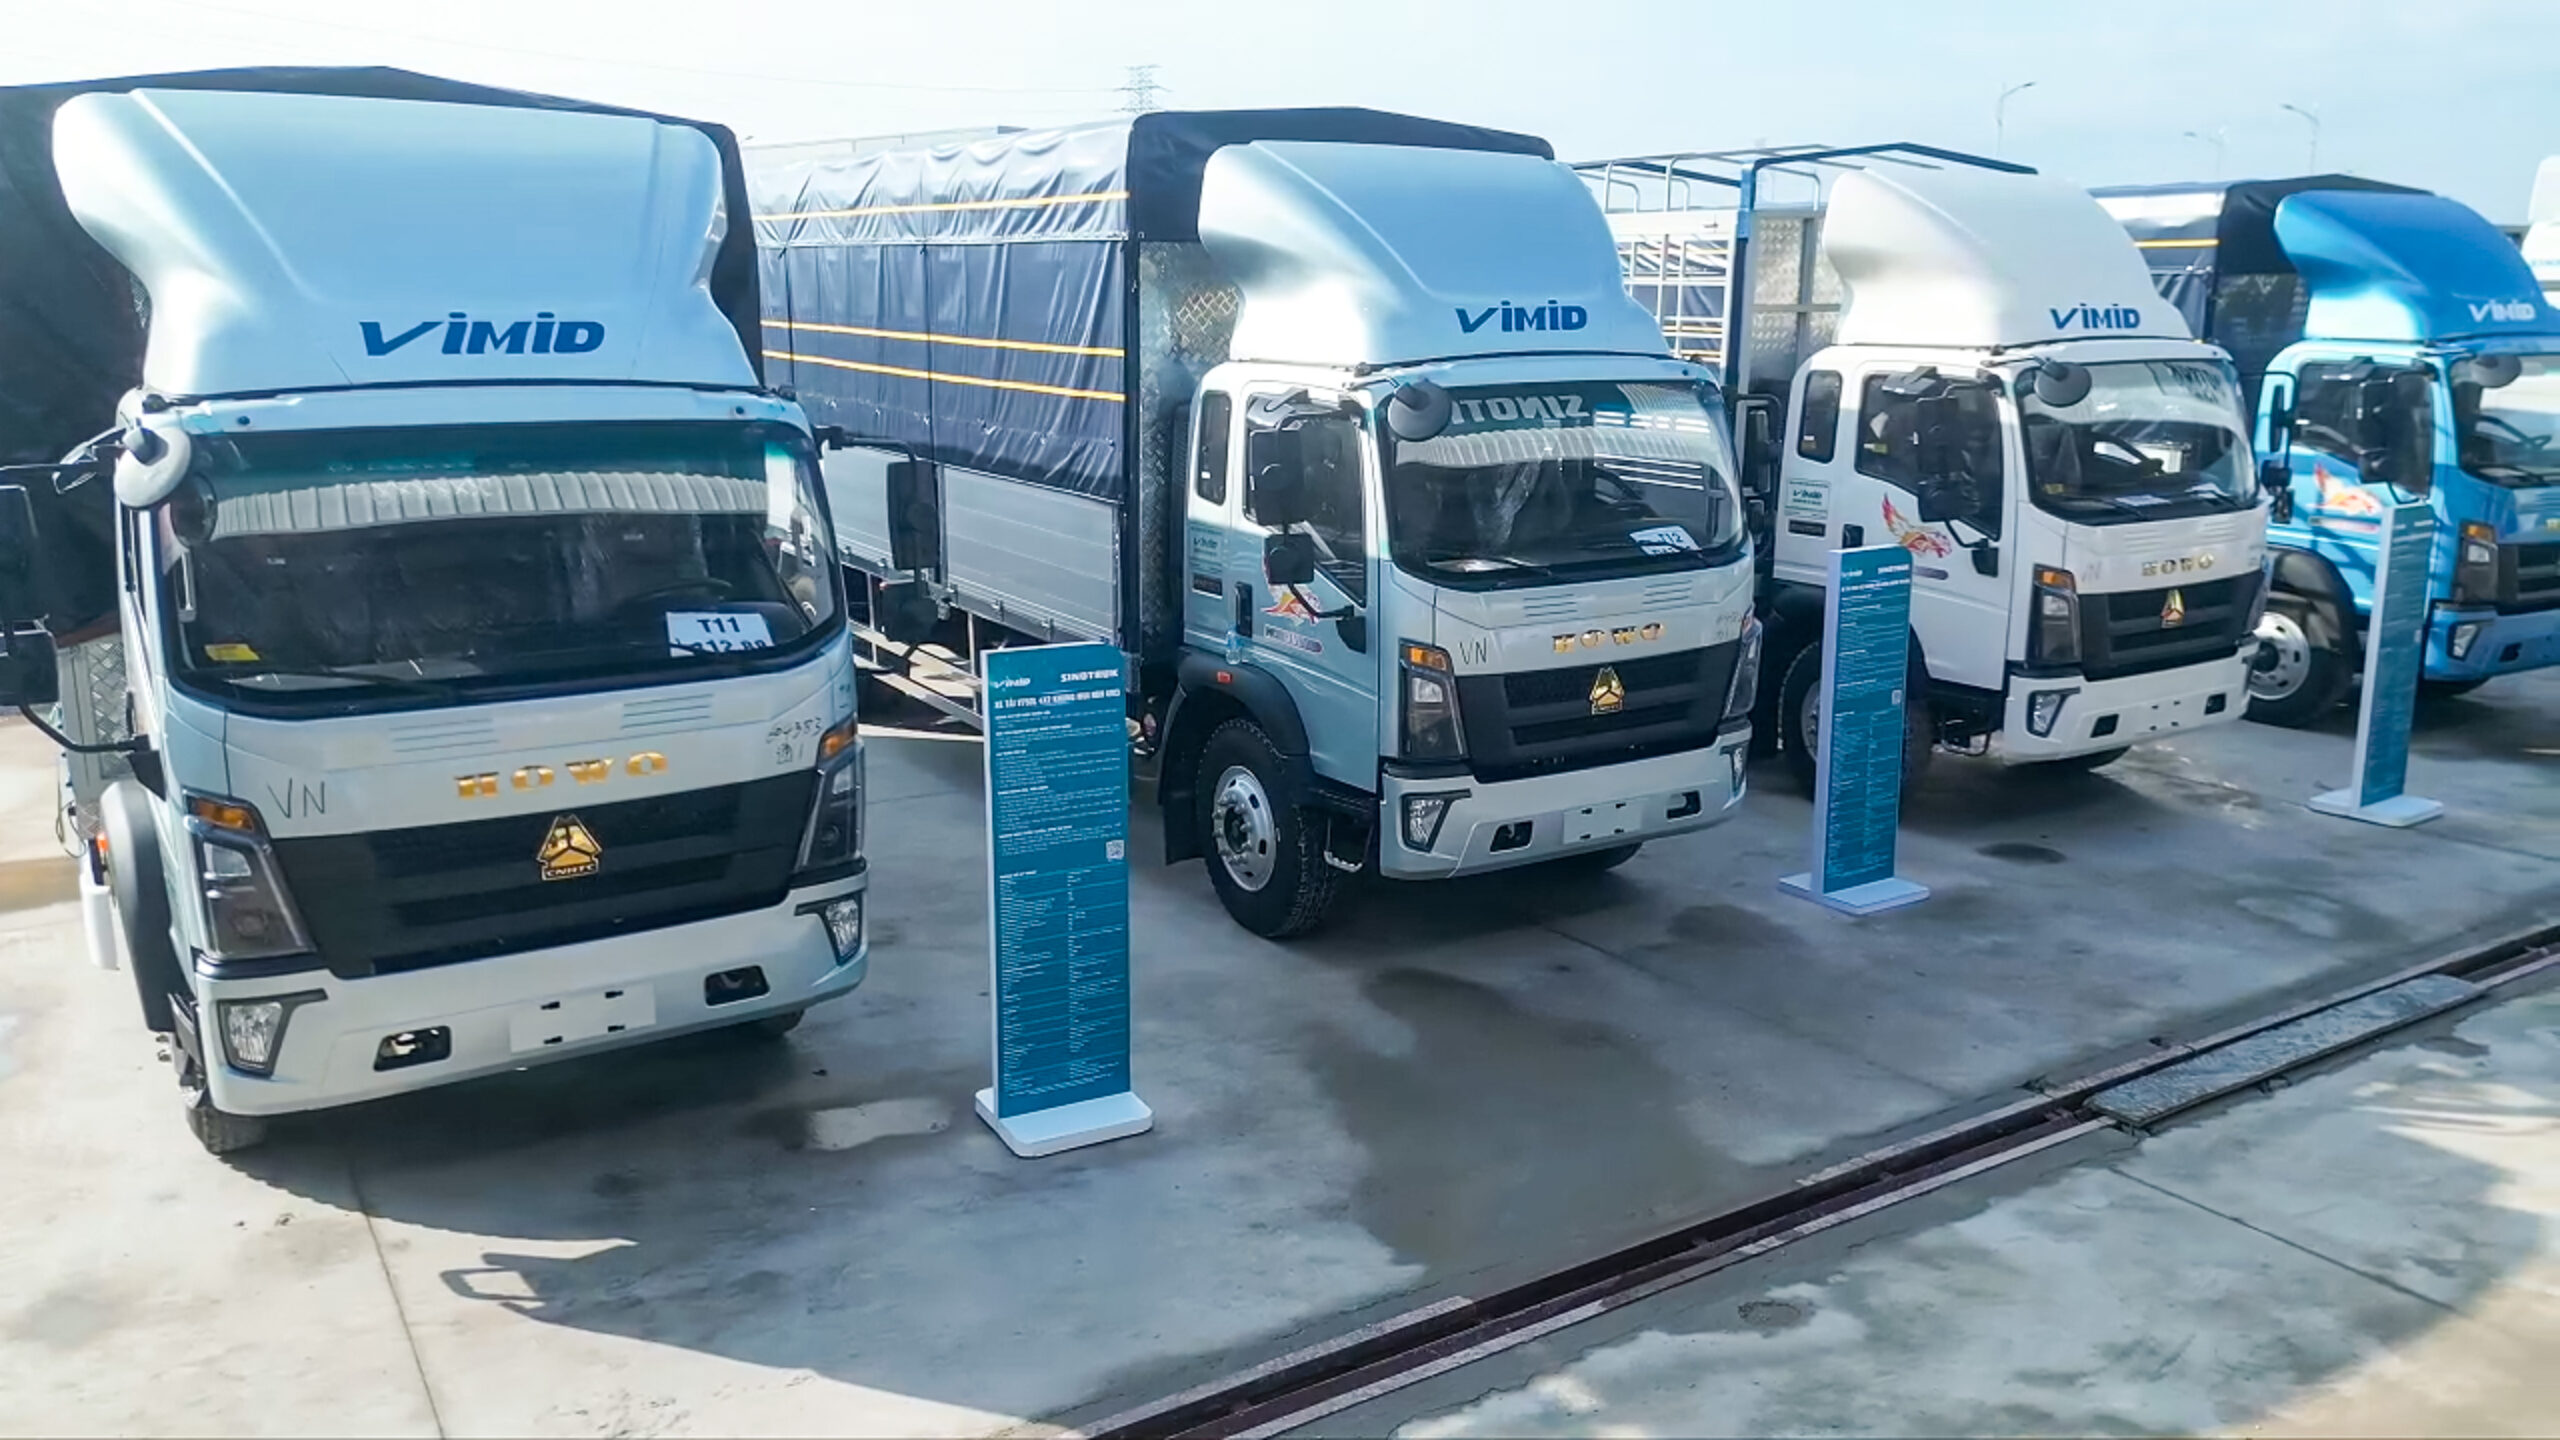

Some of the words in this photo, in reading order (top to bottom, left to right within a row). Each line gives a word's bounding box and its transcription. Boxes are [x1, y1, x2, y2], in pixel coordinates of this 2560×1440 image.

[697, 616, 741, 633] T11
[1552, 622, 1665, 654] HOWO
[1459, 637, 1488, 665] VN
[454, 750, 668, 799] HOWO
[267, 777, 326, 819] VN
